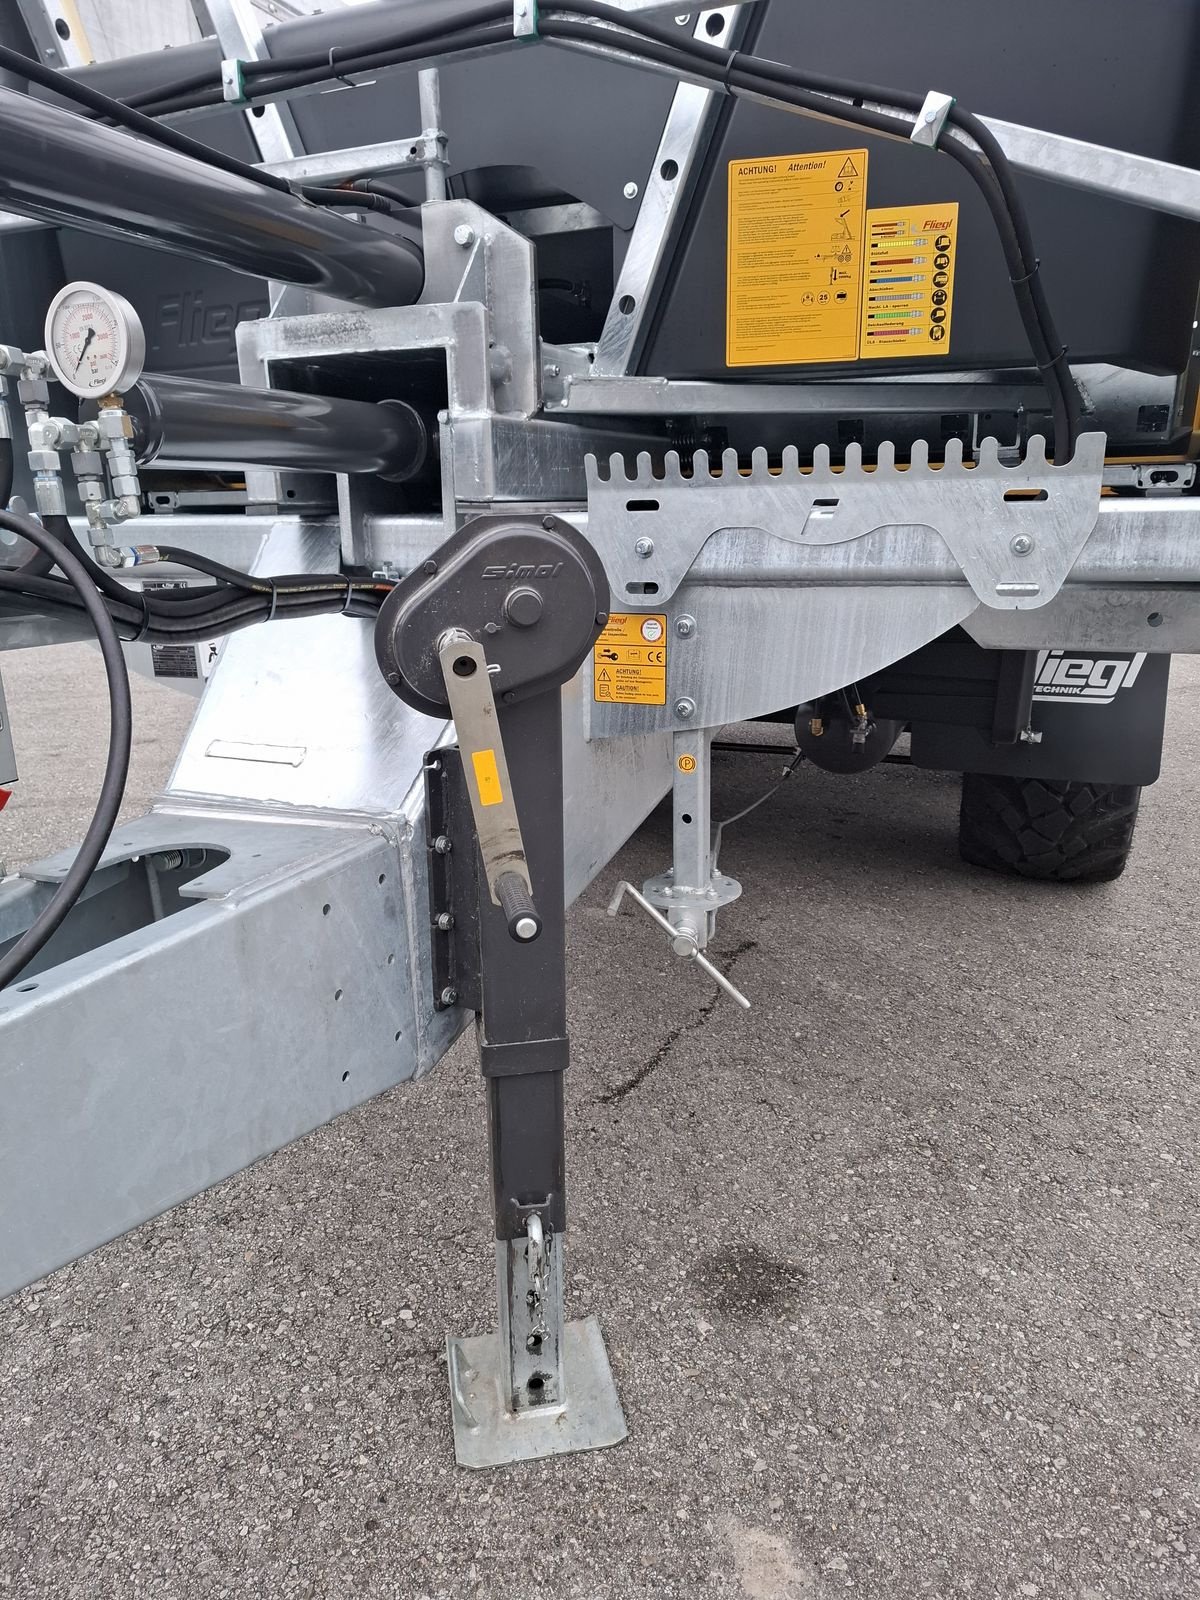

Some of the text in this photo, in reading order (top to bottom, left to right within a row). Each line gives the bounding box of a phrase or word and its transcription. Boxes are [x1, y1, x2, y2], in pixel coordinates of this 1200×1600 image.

[738, 160, 826, 176] ACHTUNG! Attention!
[923, 218, 953, 231] Fliegl
[82, 313, 94, 321] 2000
[608, 616, 628, 625] liegl
[647, 651, 662, 663] CE
[1034, 650, 1147, 696] liegl
[1034, 685, 1081, 694] ECHNIK
